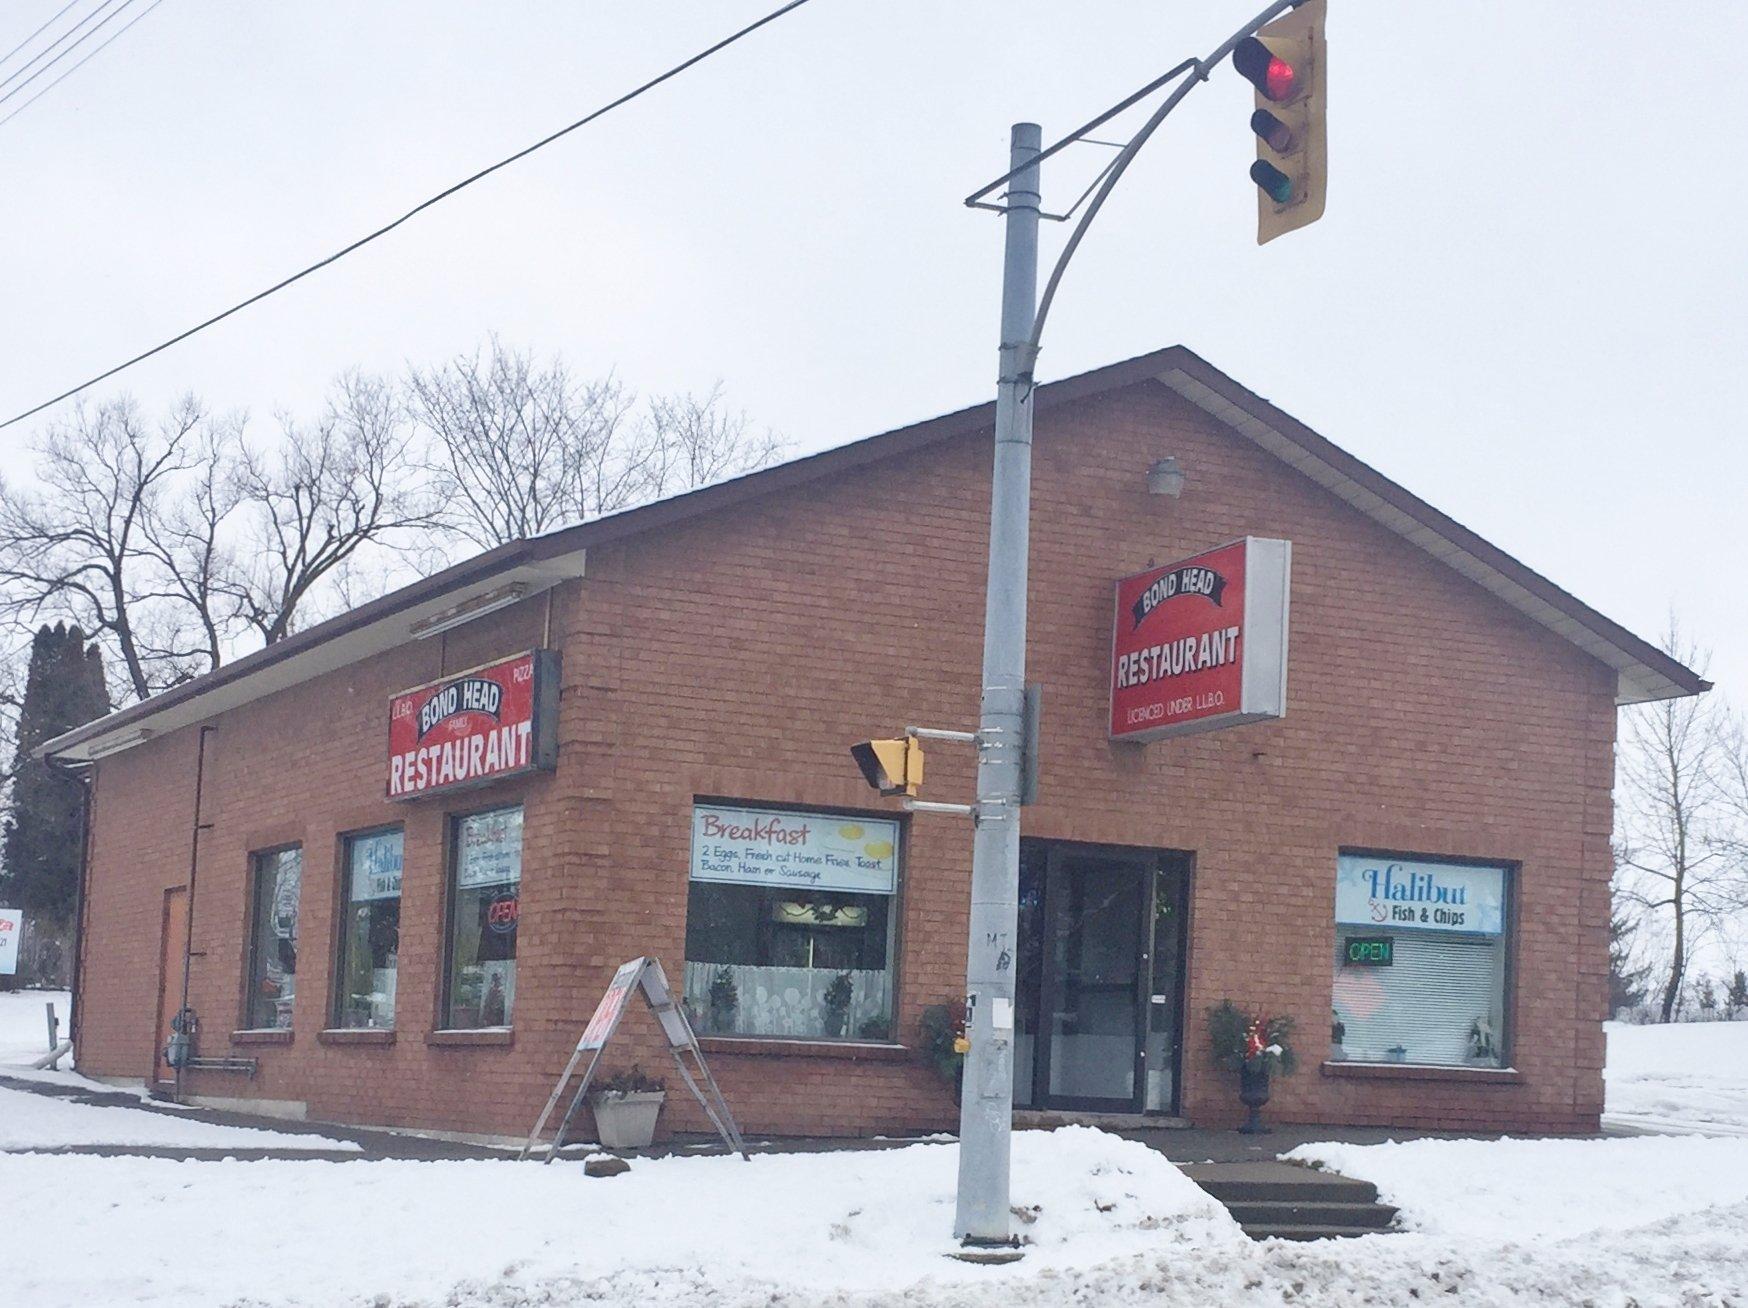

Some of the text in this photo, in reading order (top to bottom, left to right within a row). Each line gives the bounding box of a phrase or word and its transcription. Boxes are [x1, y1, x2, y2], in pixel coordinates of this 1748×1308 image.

[1142, 569, 1214, 613] BOND HEAD
[1118, 626, 1240, 689] RESTAURANT
[422, 682, 500, 737] BOND HEAD
[1167, 697, 1193, 716] UNDER
[391, 720, 532, 795] RESTAURANT
[701, 814, 811, 846] Breakfast
[702, 845, 709, 856] 2
[745, 848, 772, 860] Fresh
[776, 852, 790, 863] cut
[794, 852, 822, 865] Home
[856, 856, 882, 869] Toast
[738, 862, 761, 874] Ham
[779, 865, 821, 884] Sausage
[1362, 864, 1468, 905] Halibut
[1392, 905, 1465, 926] Fish & Chips
[1350, 943, 1390, 960] OPEN
